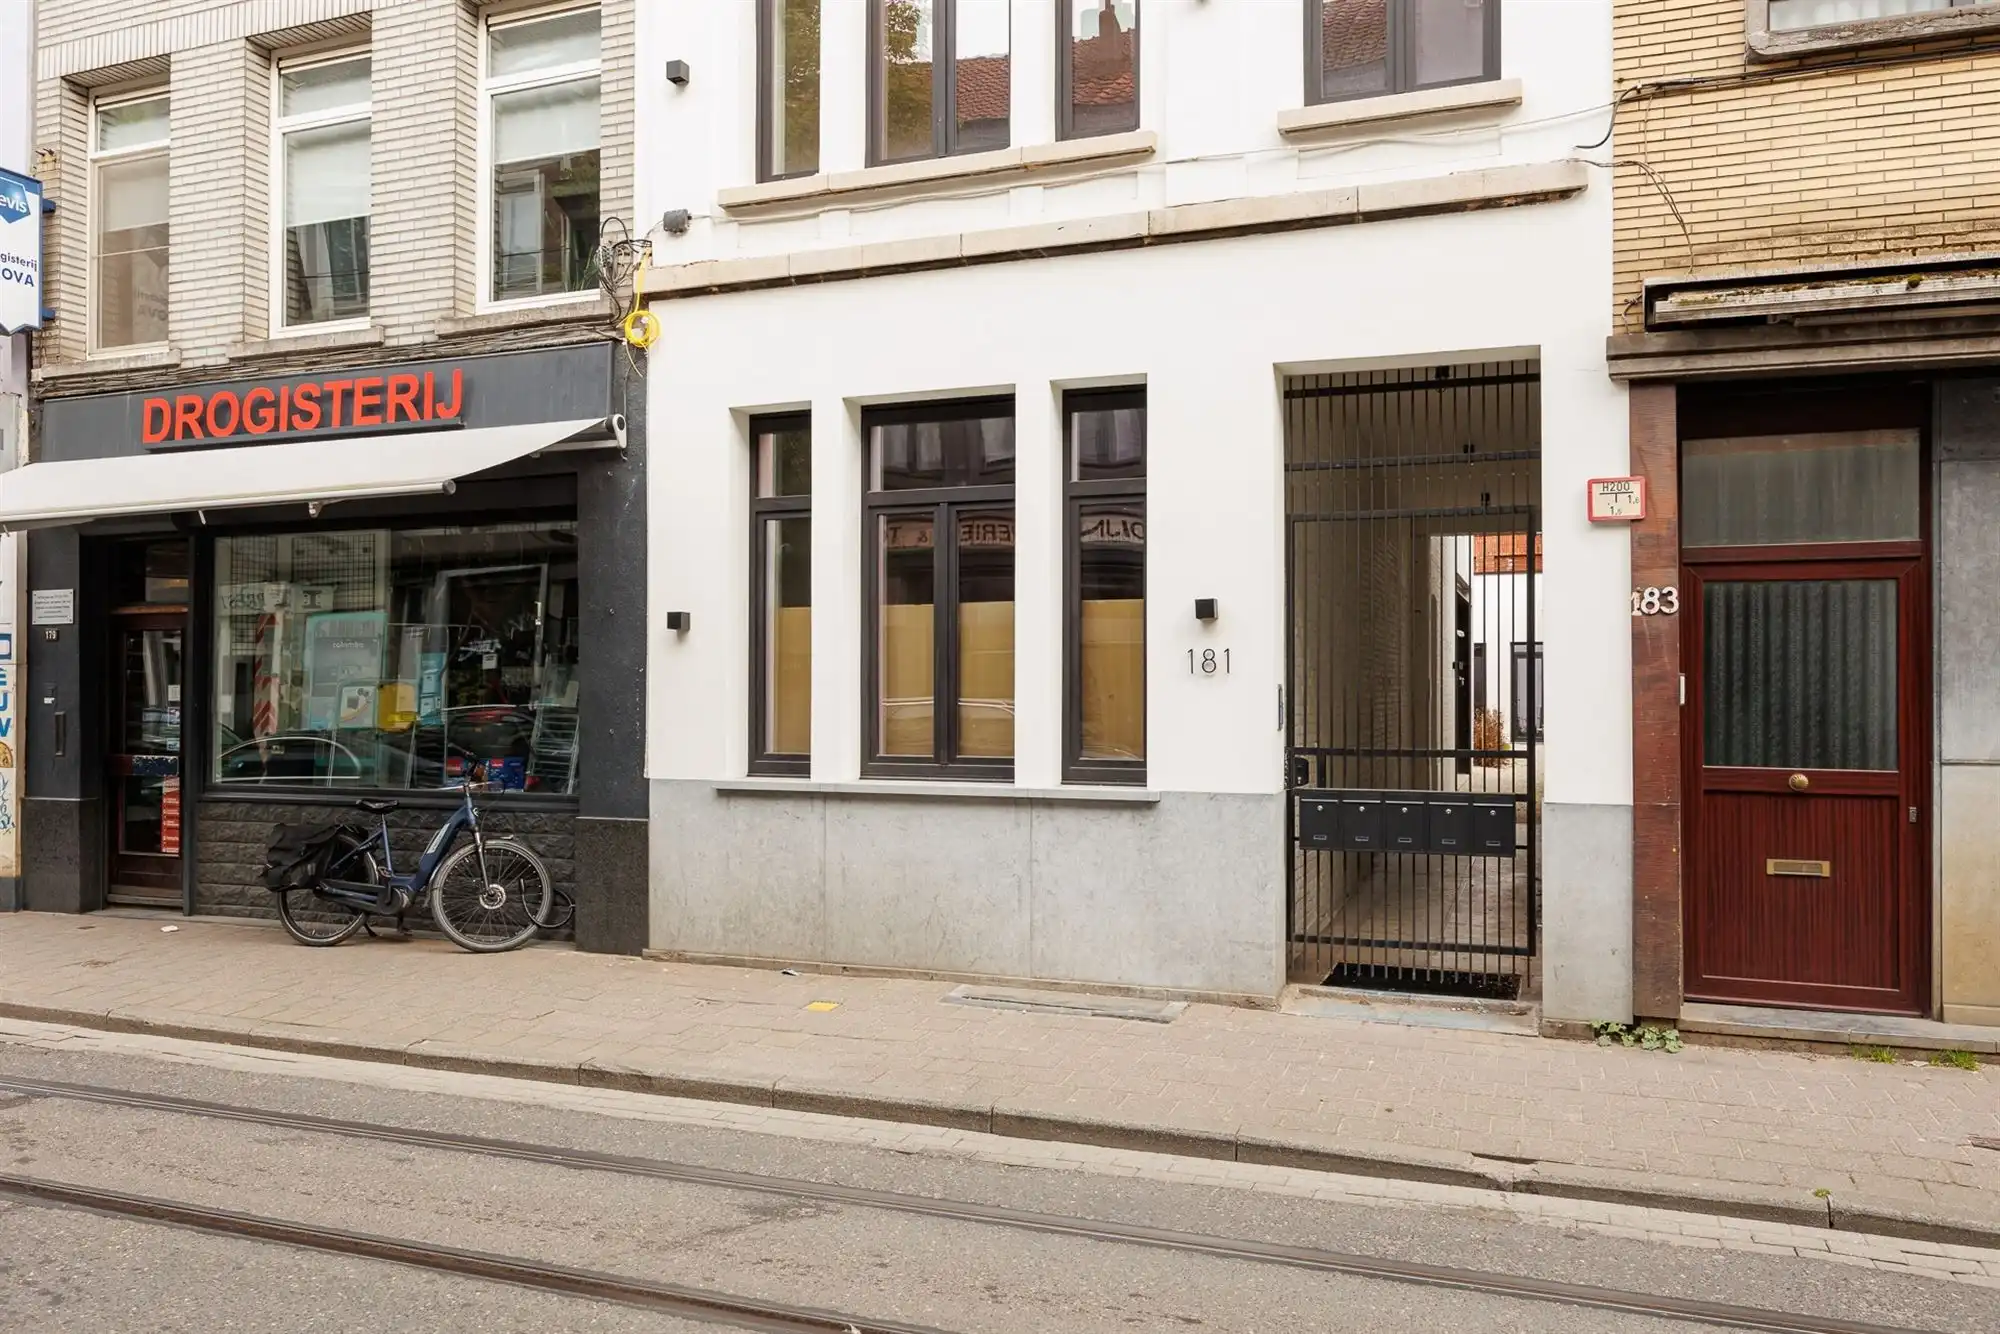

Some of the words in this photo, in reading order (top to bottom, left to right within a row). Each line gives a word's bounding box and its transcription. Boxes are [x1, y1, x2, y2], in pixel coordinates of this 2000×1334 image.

[2, 267, 34, 287] OVA
[142, 368, 464, 444] DROGISTERIJ
[1602, 481, 1630, 492] H200
[1631, 586, 1679, 615] 183
[1187, 648, 1230, 674] 181
